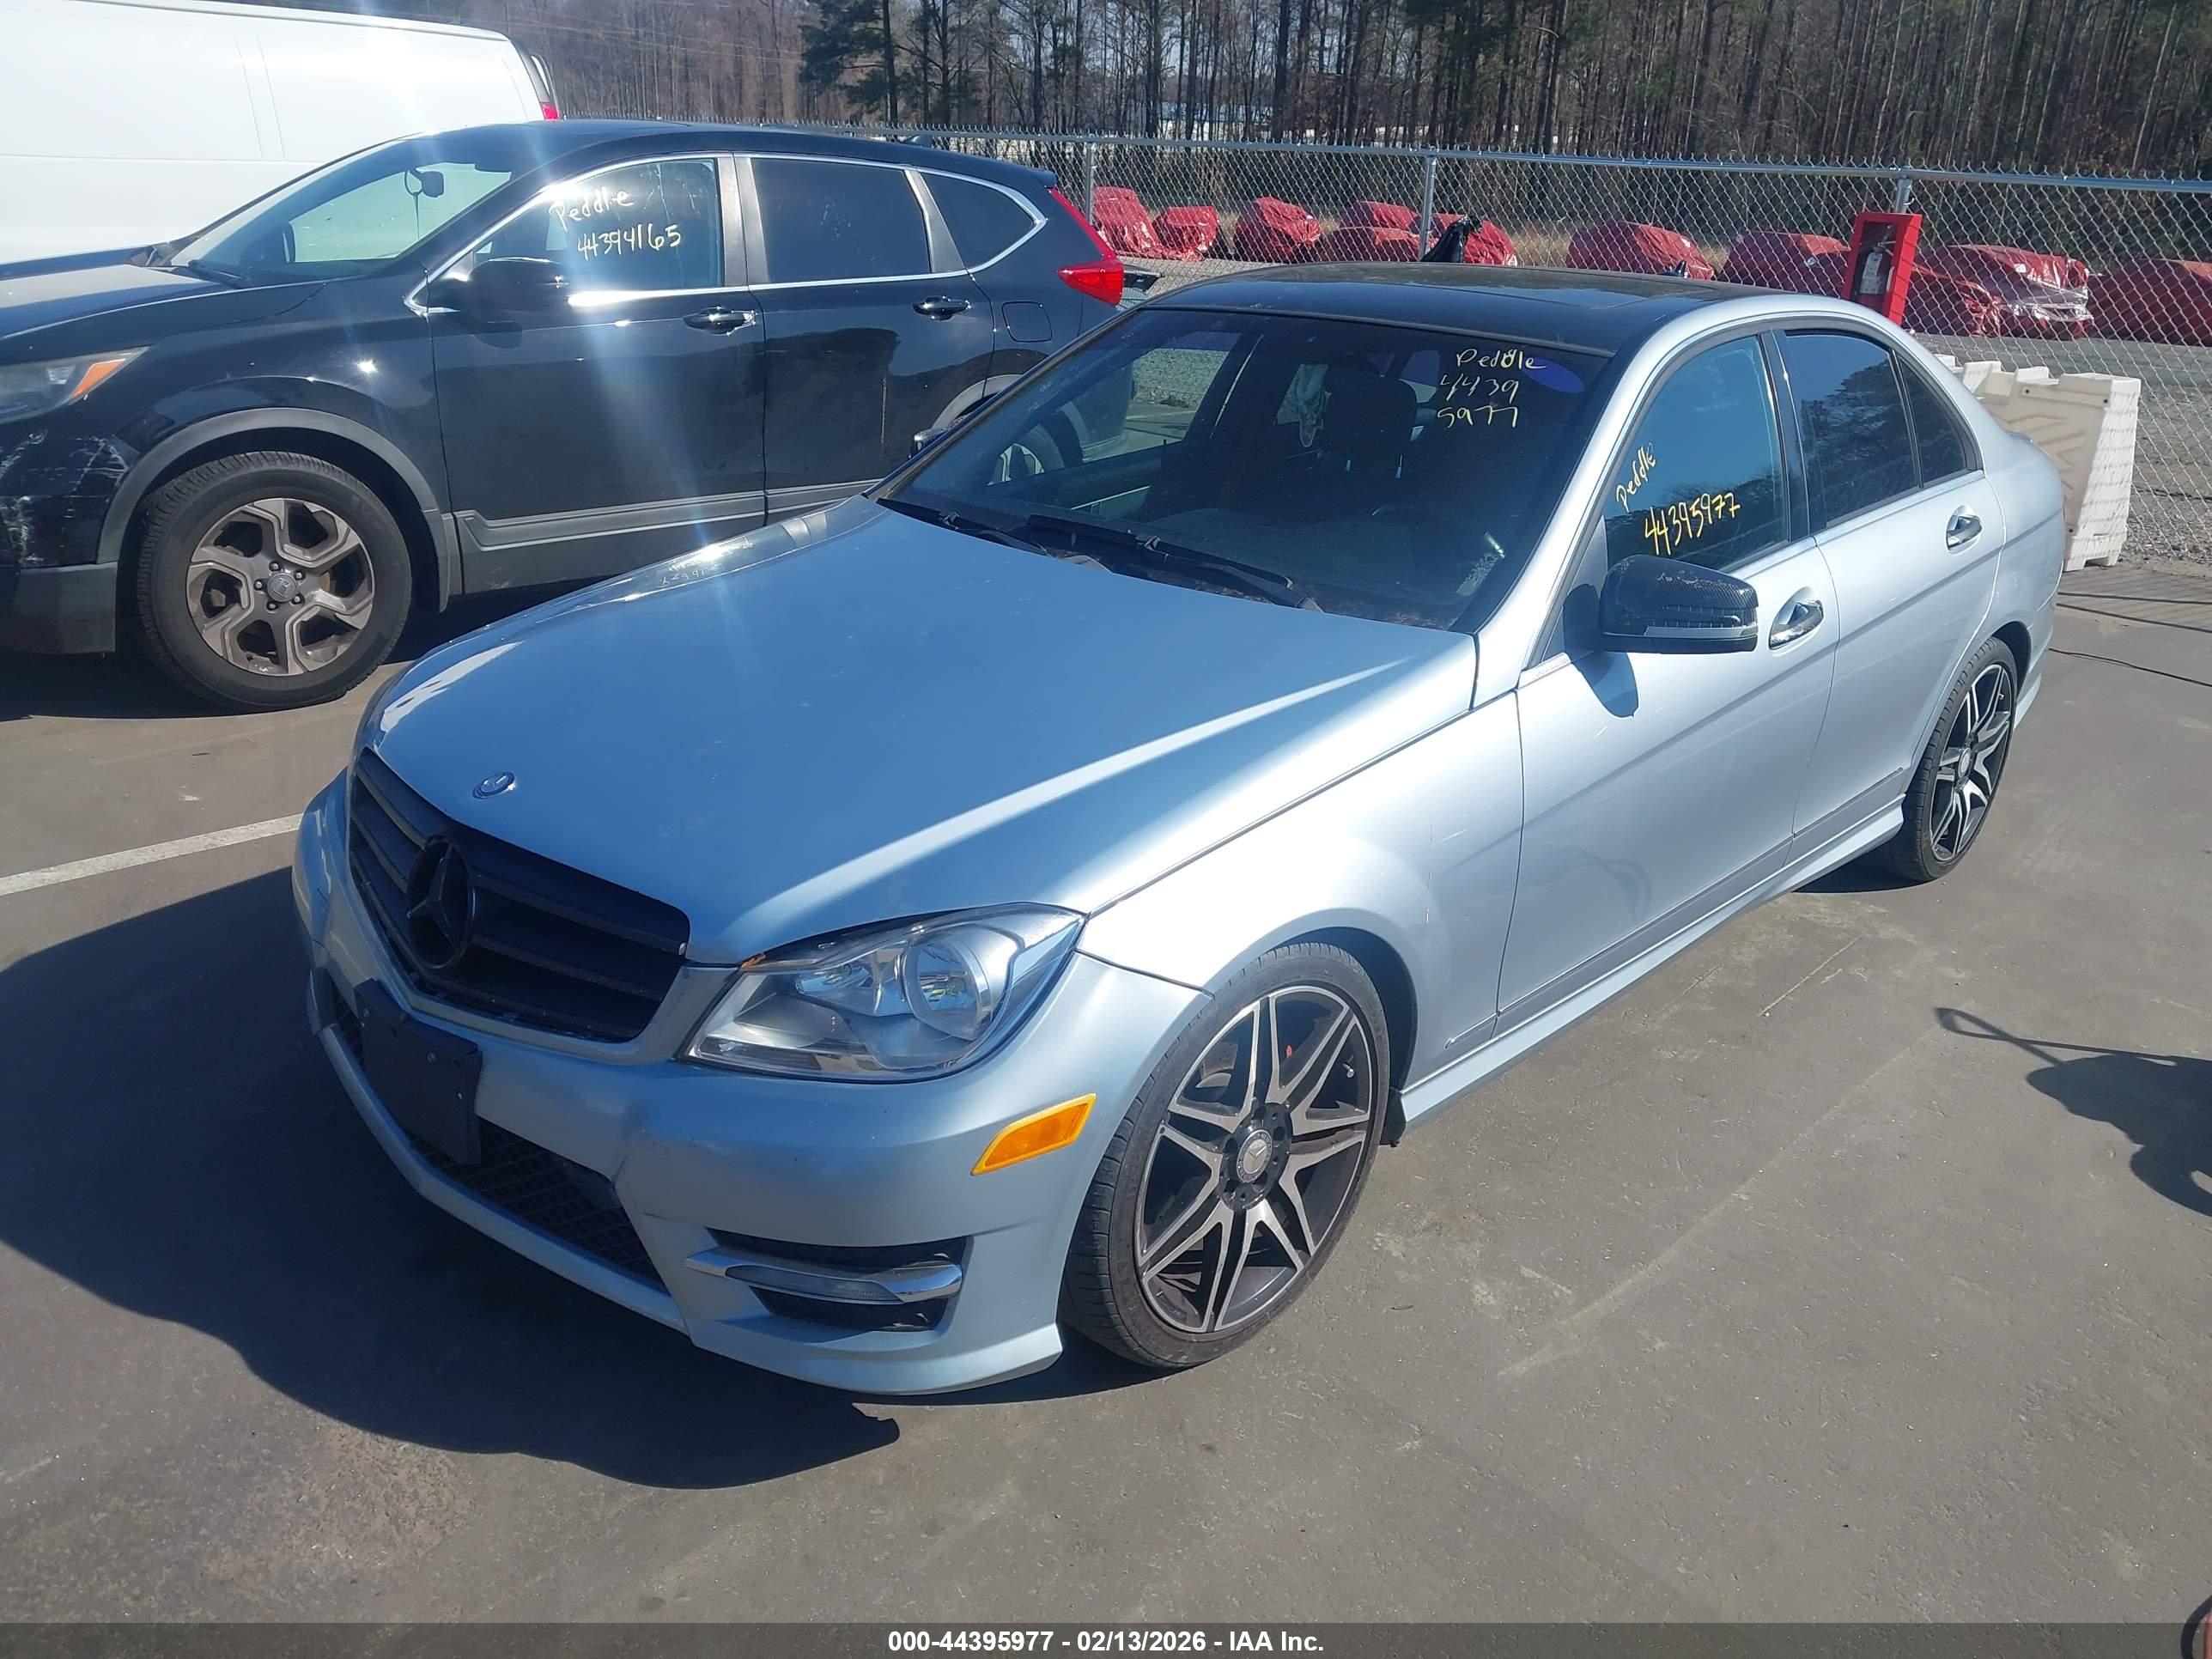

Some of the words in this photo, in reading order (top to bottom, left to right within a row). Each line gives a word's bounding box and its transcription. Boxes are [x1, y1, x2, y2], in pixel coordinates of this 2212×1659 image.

[549, 186, 635, 232] Peddle
[577, 223, 681, 261] 44394165
[1456, 349, 1548, 370] Peddle
[1440, 373, 1519, 404] 4439
[1437, 404, 1518, 428] 5977
[1644, 492, 1741, 556] 44395977
